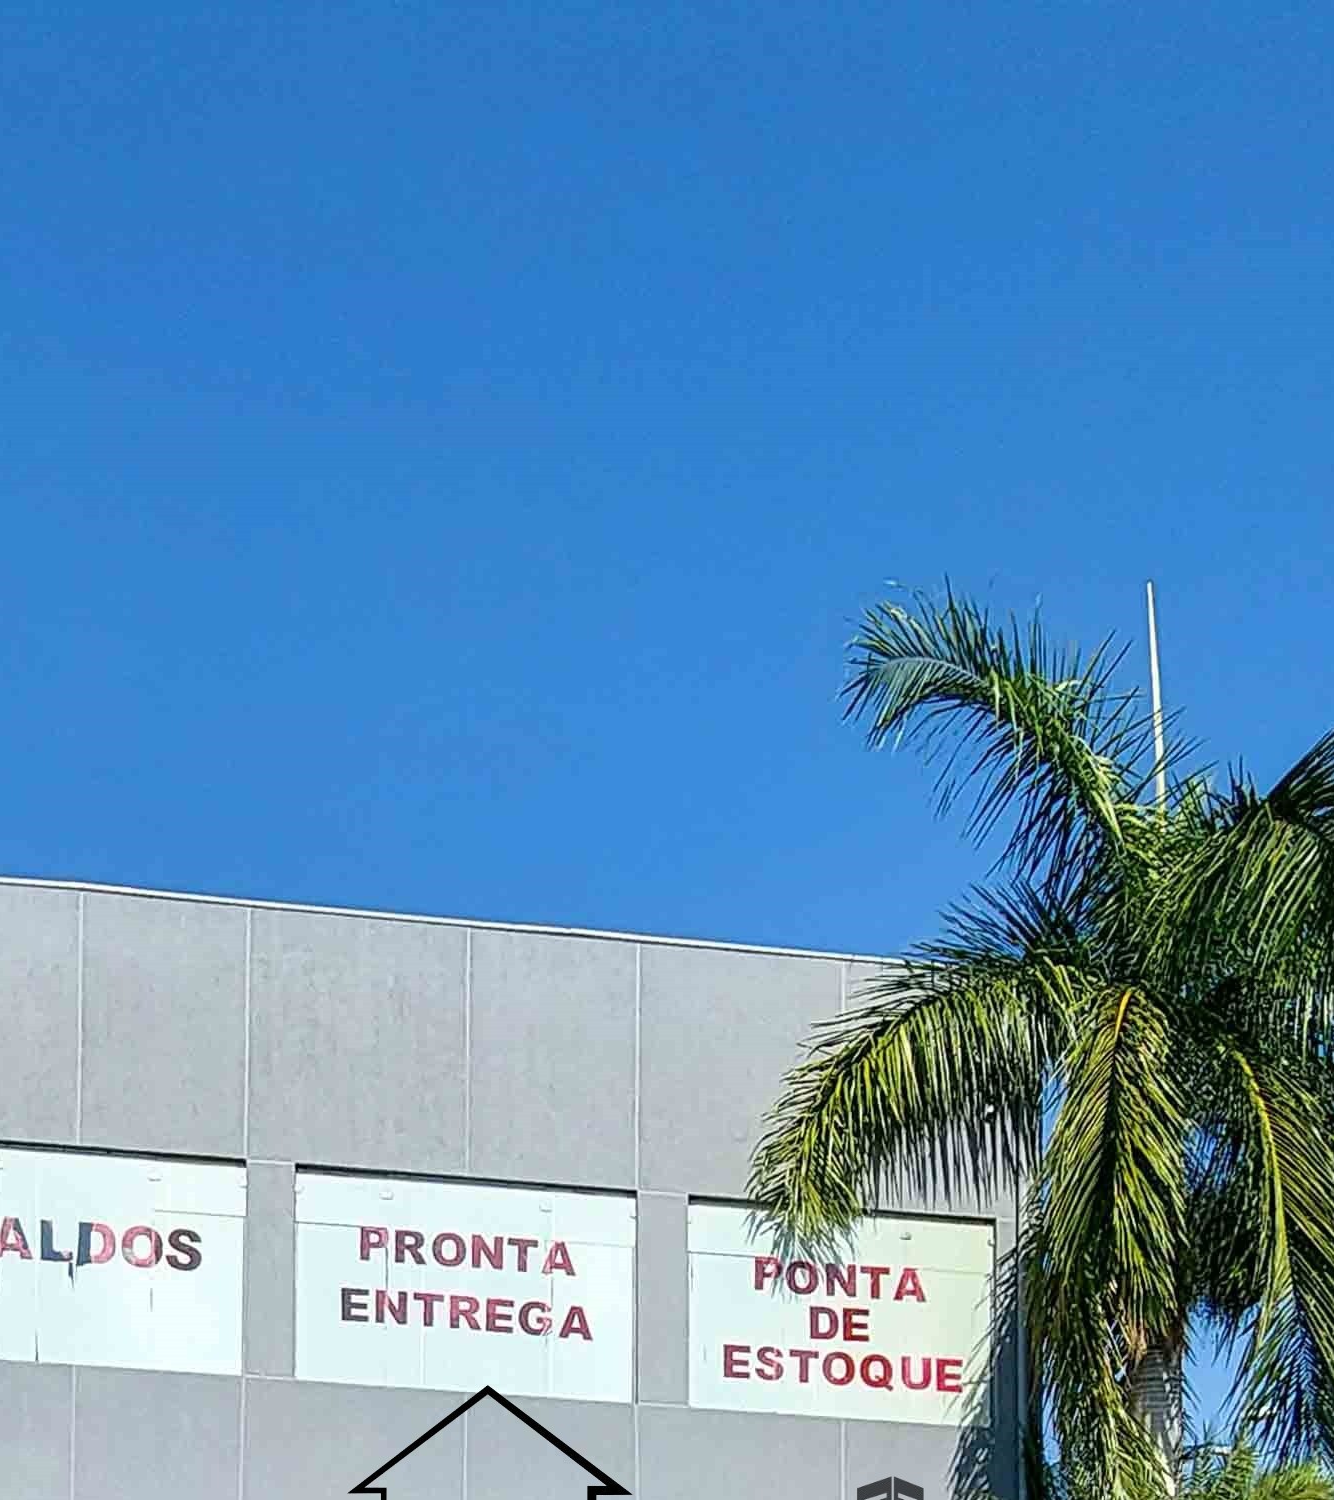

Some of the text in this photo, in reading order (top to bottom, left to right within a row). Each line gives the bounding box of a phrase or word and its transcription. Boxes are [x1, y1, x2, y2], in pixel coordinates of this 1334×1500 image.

[359, 1226, 577, 1277] PRONTA
[753, 1255, 928, 1303] PONTA
[340, 1287, 594, 1342] ENTREGA
[809, 1306, 871, 1342] DE
[723, 1344, 964, 1394] ESTOQUE
